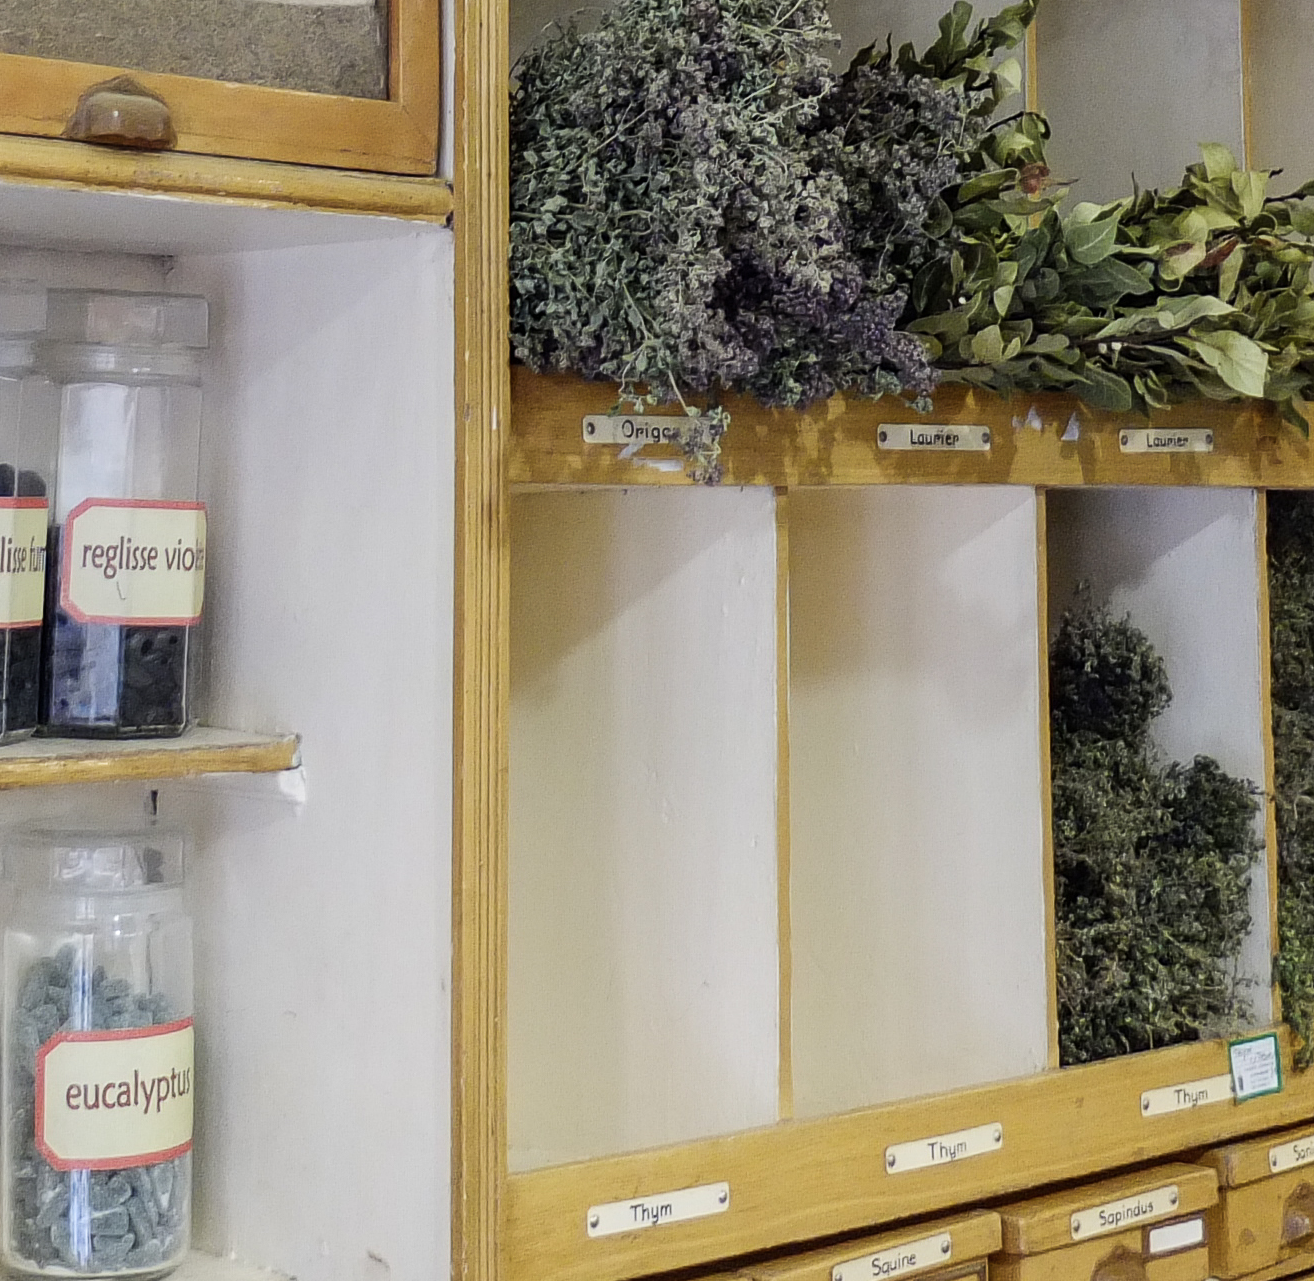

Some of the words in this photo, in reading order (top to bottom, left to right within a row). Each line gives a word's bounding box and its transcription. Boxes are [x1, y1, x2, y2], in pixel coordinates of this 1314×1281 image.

[910, 429, 960, 447] Laurier
[1146, 432, 1189, 449] Laurier
[81, 535, 159, 580] reglisse
[65, 1065, 191, 1116] eucalyptus
[1173, 1088, 1210, 1109] Thym
[928, 1139, 969, 1162] Thym
[630, 1203, 674, 1227] Thym
[1098, 1201, 1154, 1226] Sapindus
[870, 1251, 918, 1278] Squine
